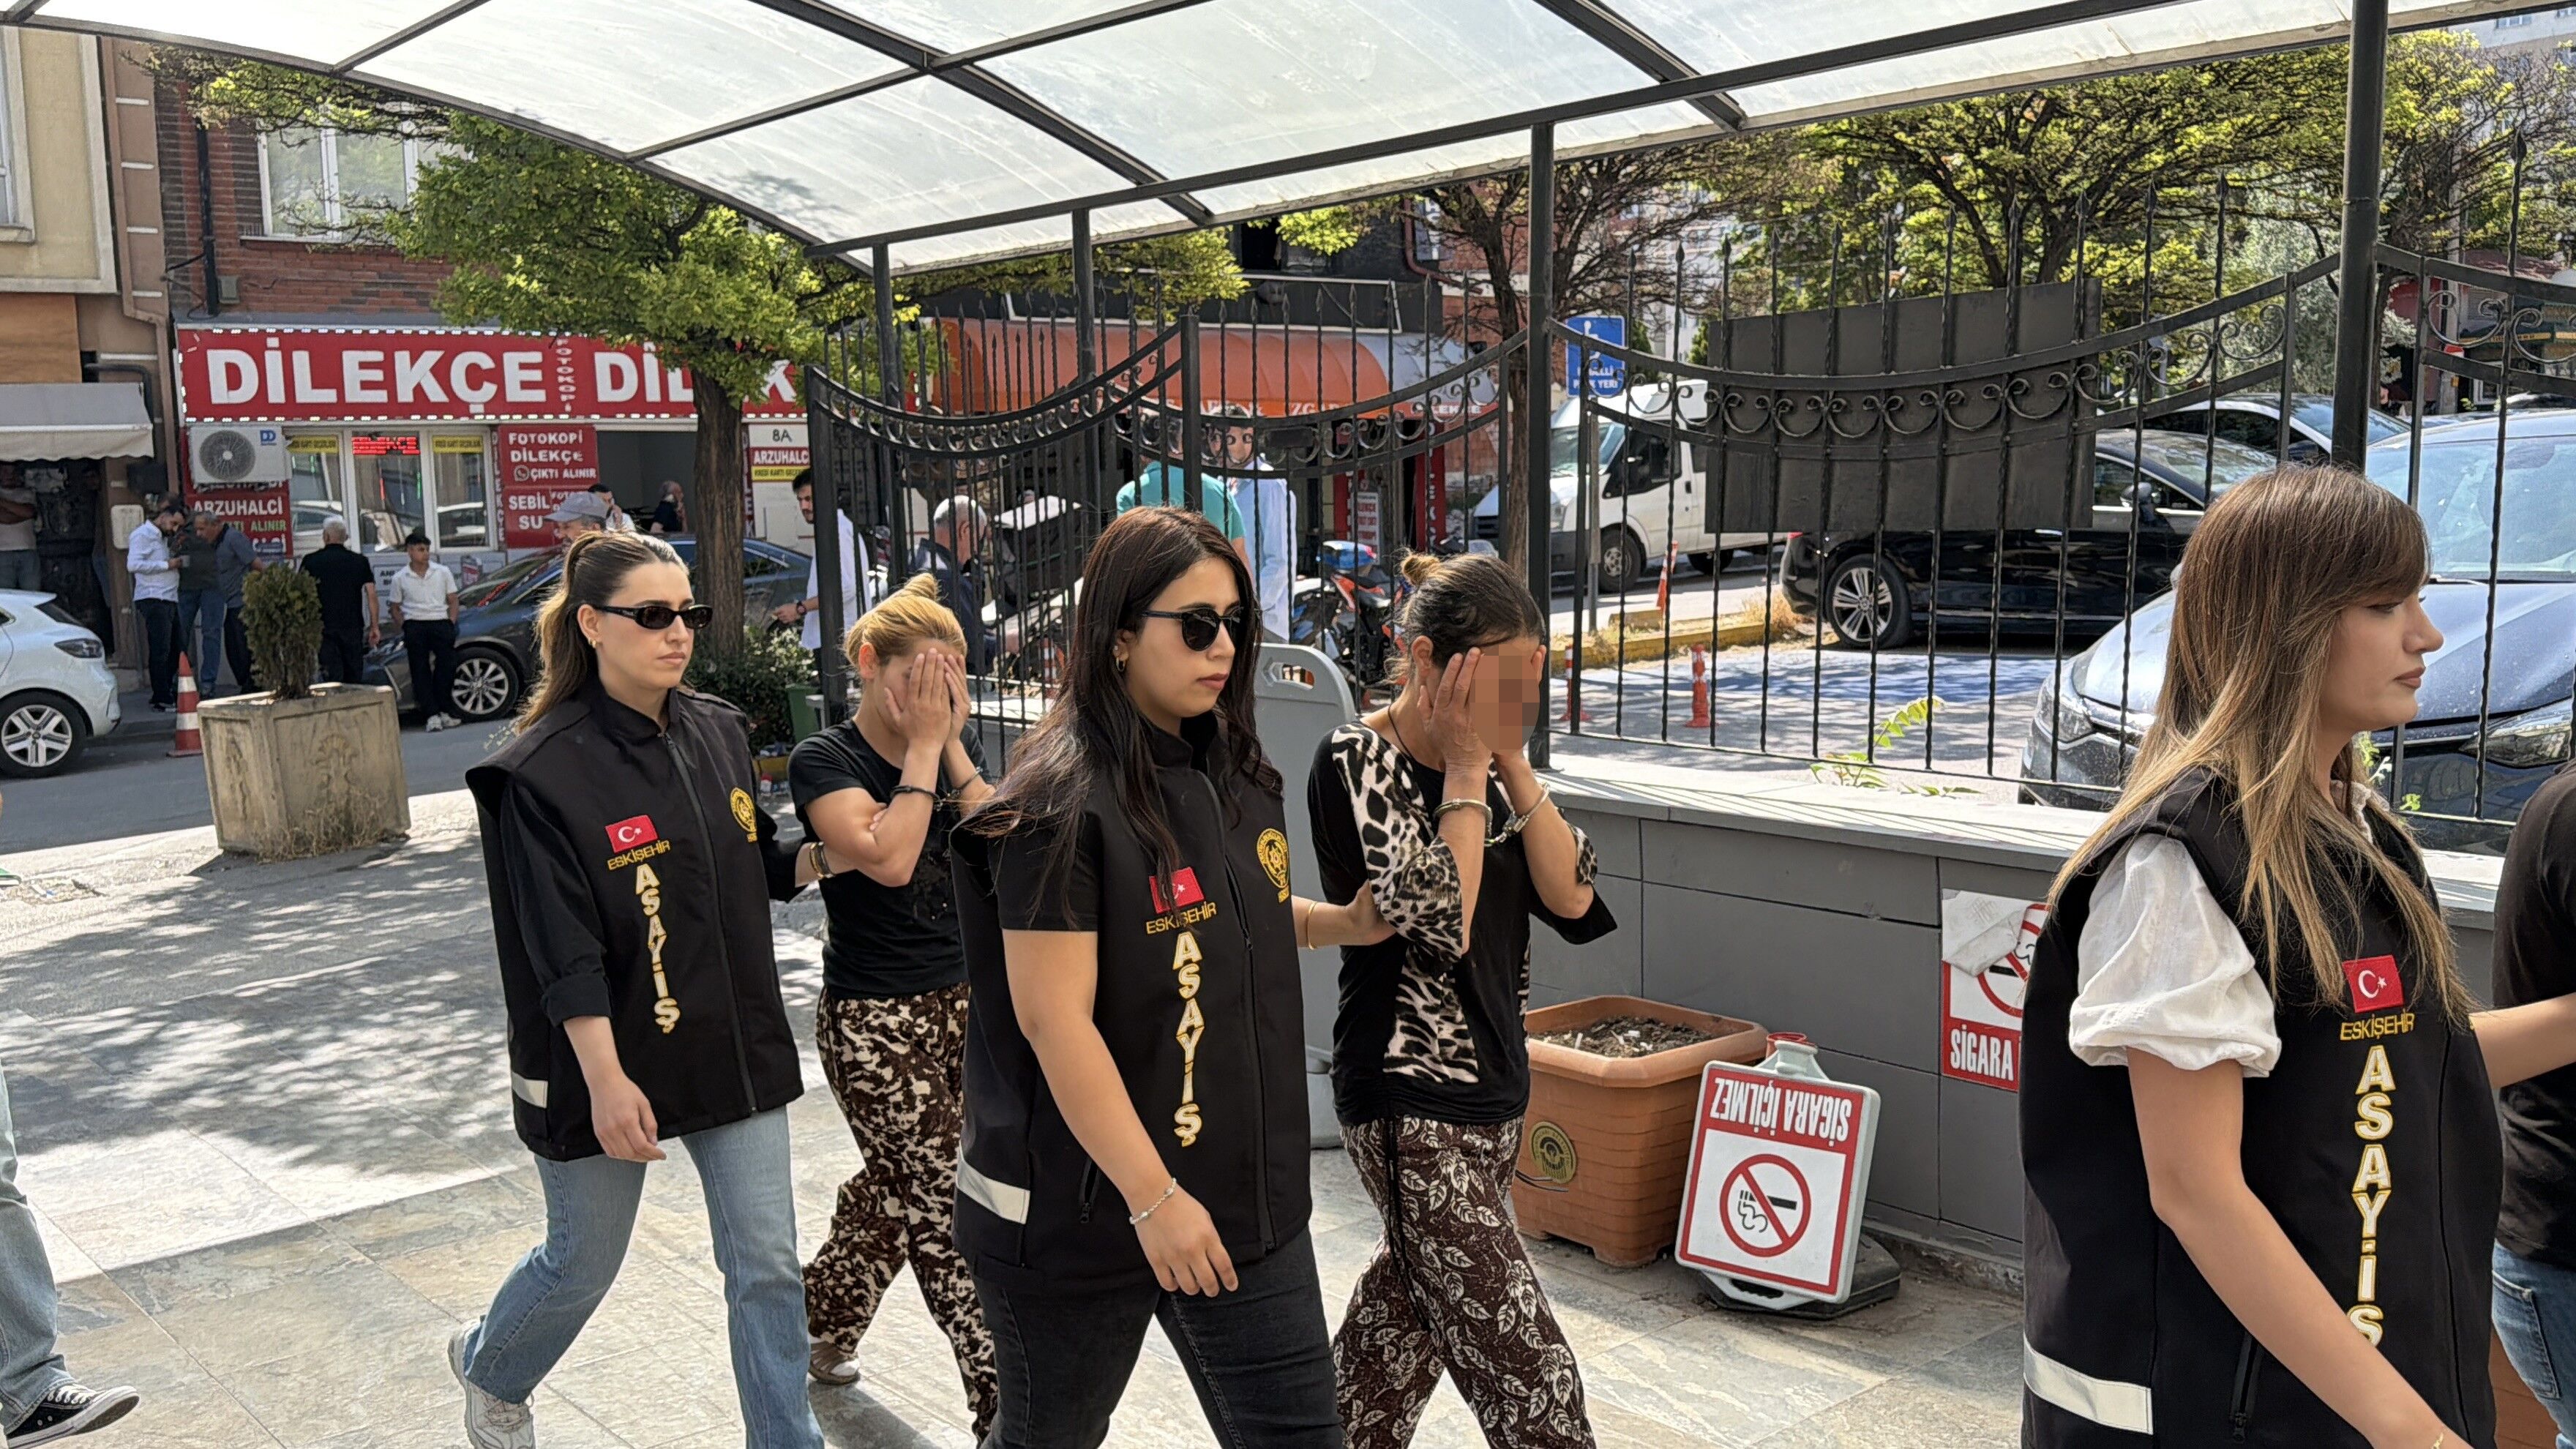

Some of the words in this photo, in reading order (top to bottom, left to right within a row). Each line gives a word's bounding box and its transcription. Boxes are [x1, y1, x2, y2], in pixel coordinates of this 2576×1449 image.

[206, 337, 547, 414] DİLEKÇE
[556, 339, 577, 412] FOTOKOPİ
[509, 429, 583, 445] FOTOKOPİ
[772, 429, 793, 442] 8A
[510, 447, 583, 465] DİLEKÇE
[531, 468, 559, 482] ÇIKTI
[194, 496, 283, 516] ARZUHALCİ
[508, 491, 550, 511] SEBİL
[519, 514, 544, 531] SU
[607, 839, 671, 871] ESKİŞEHİR
[635, 863, 681, 1034] ASAYİŞ
[1172, 931, 1205, 1147] ASAYİŞ
[2340, 1008, 2415, 1041] ESKİŞEHİR
[1950, 1024, 2014, 1082] SİGARA
[1710, 1077, 1782, 1137] İÇİLMEZ
[1783, 1088, 1852, 1147] SİGARA
